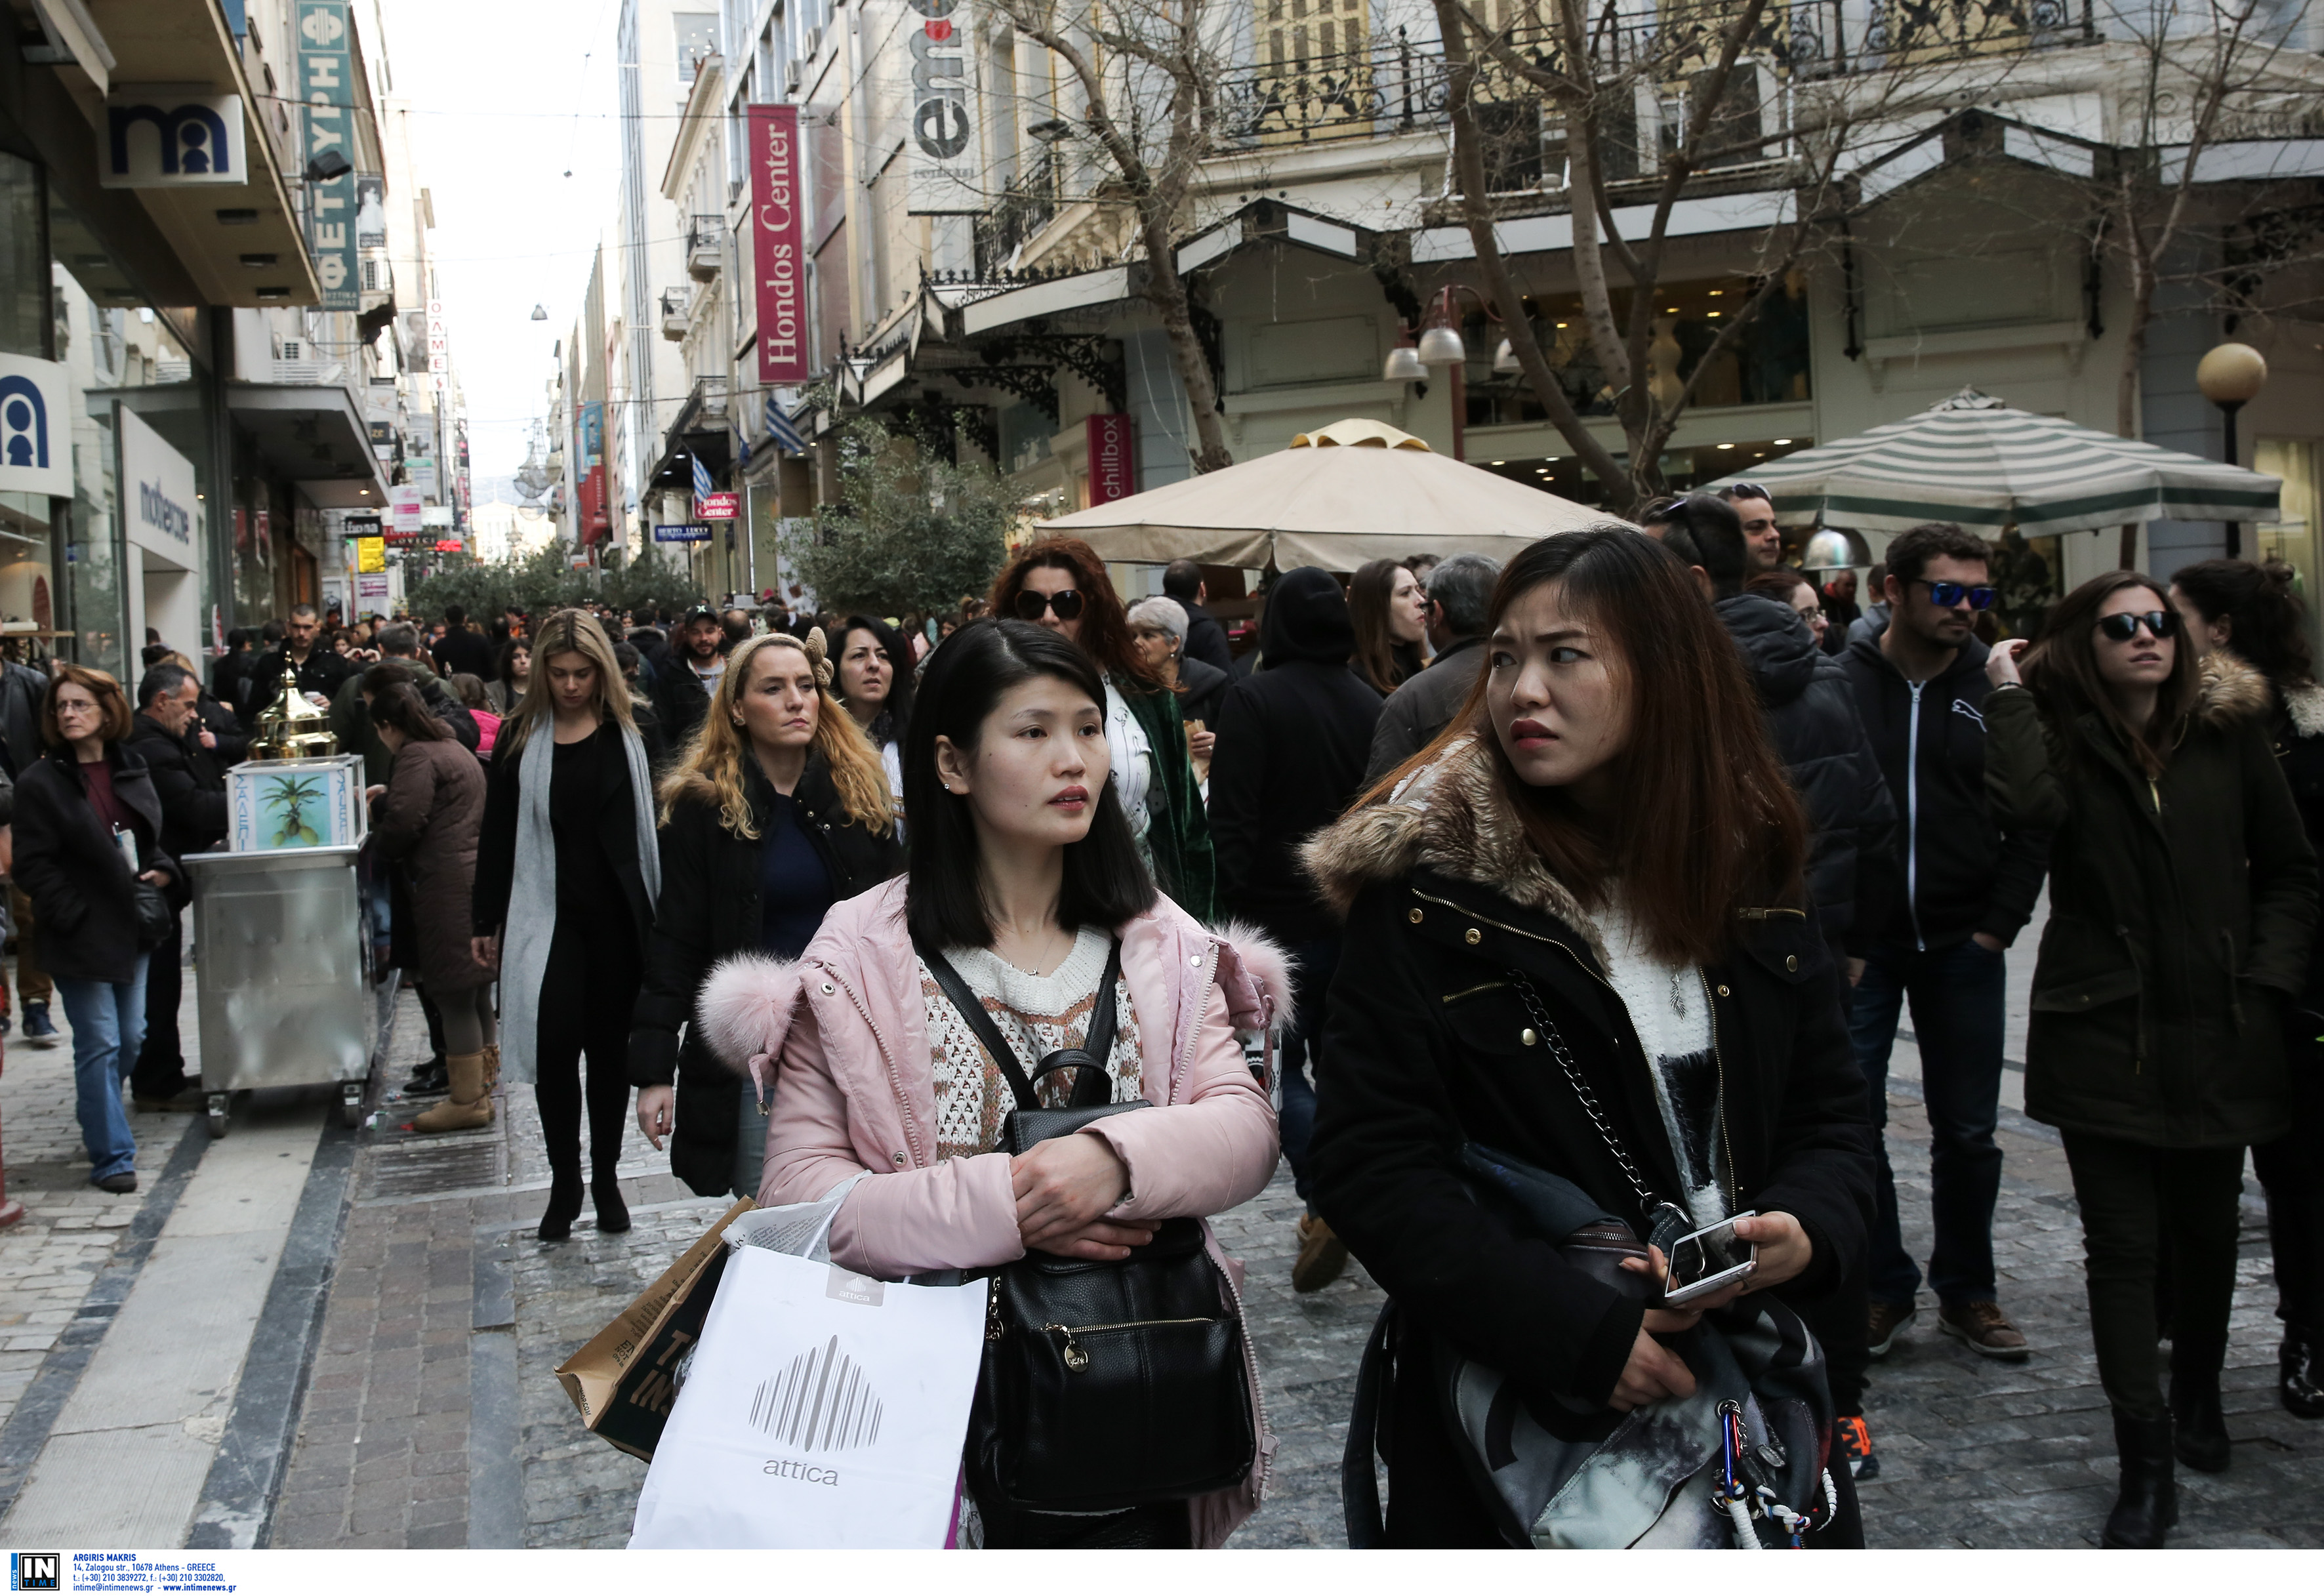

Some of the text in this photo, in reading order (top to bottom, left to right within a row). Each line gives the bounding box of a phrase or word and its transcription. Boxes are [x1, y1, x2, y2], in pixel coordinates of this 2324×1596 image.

[308, 57, 348, 290] ΦΕΤΥΡΗ
[761, 123, 798, 367] Hondos Center
[1101, 419, 1121, 498] chillbox
[698, 504, 733, 517] Center
[236, 774, 249, 851] ΣΑΛΕΠΙ
[839, 1290, 870, 1301] attica
[615, 1346, 629, 1361] NOT
[763, 1460, 838, 1486] attica
